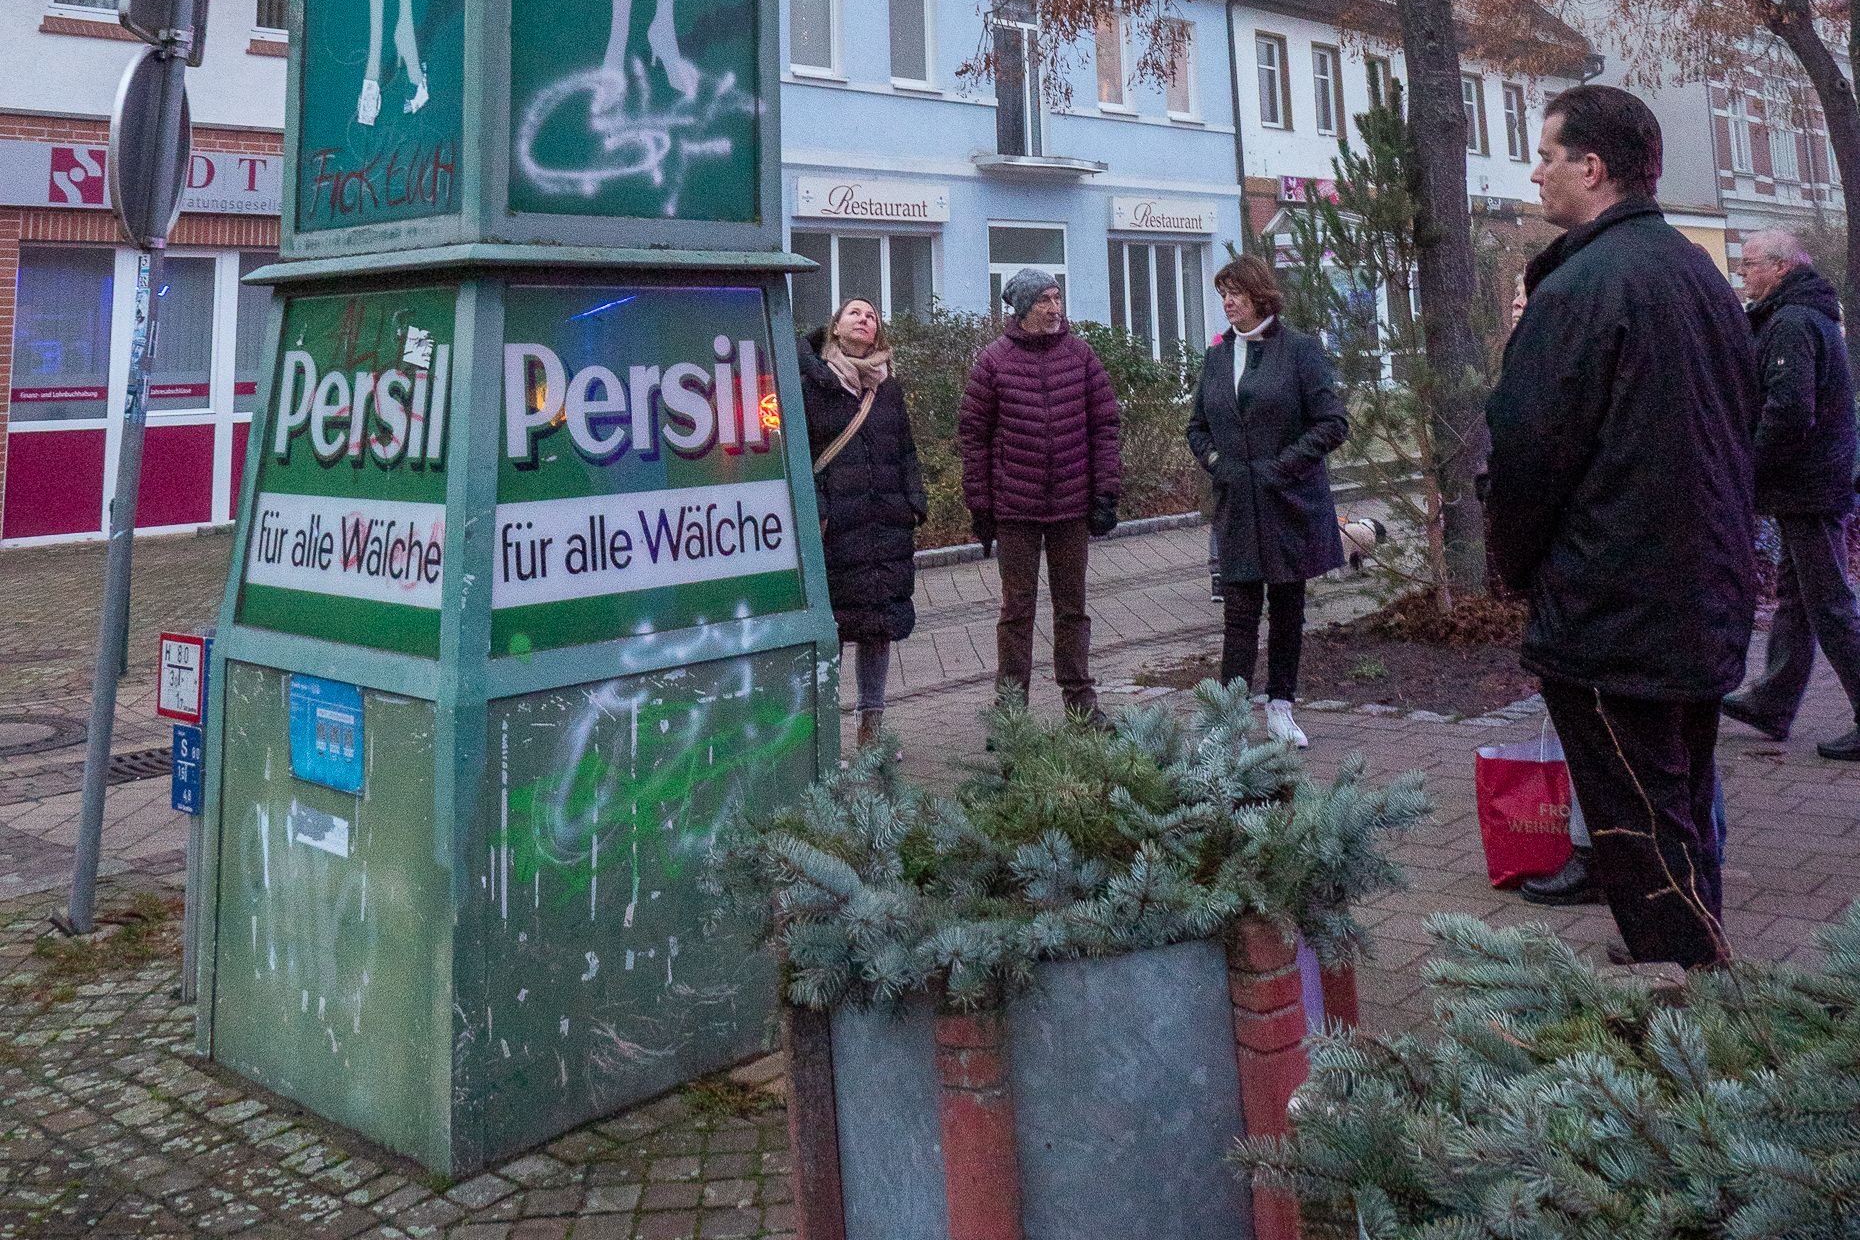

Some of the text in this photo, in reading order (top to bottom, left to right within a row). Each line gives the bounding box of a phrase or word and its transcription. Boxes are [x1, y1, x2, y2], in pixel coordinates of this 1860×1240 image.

[821, 184, 928, 217] Restaurant
[1130, 202, 1203, 230] Restaurant
[275, 344, 450, 459] Persil
[504, 335, 766, 461] Persil
[258, 510, 288, 564] für
[291, 514, 334, 571] alle
[501, 521, 552, 583] für
[564, 514, 633, 575] alle
[181, 738, 188, 758] S
[1539, 803, 1571, 818] FRO
